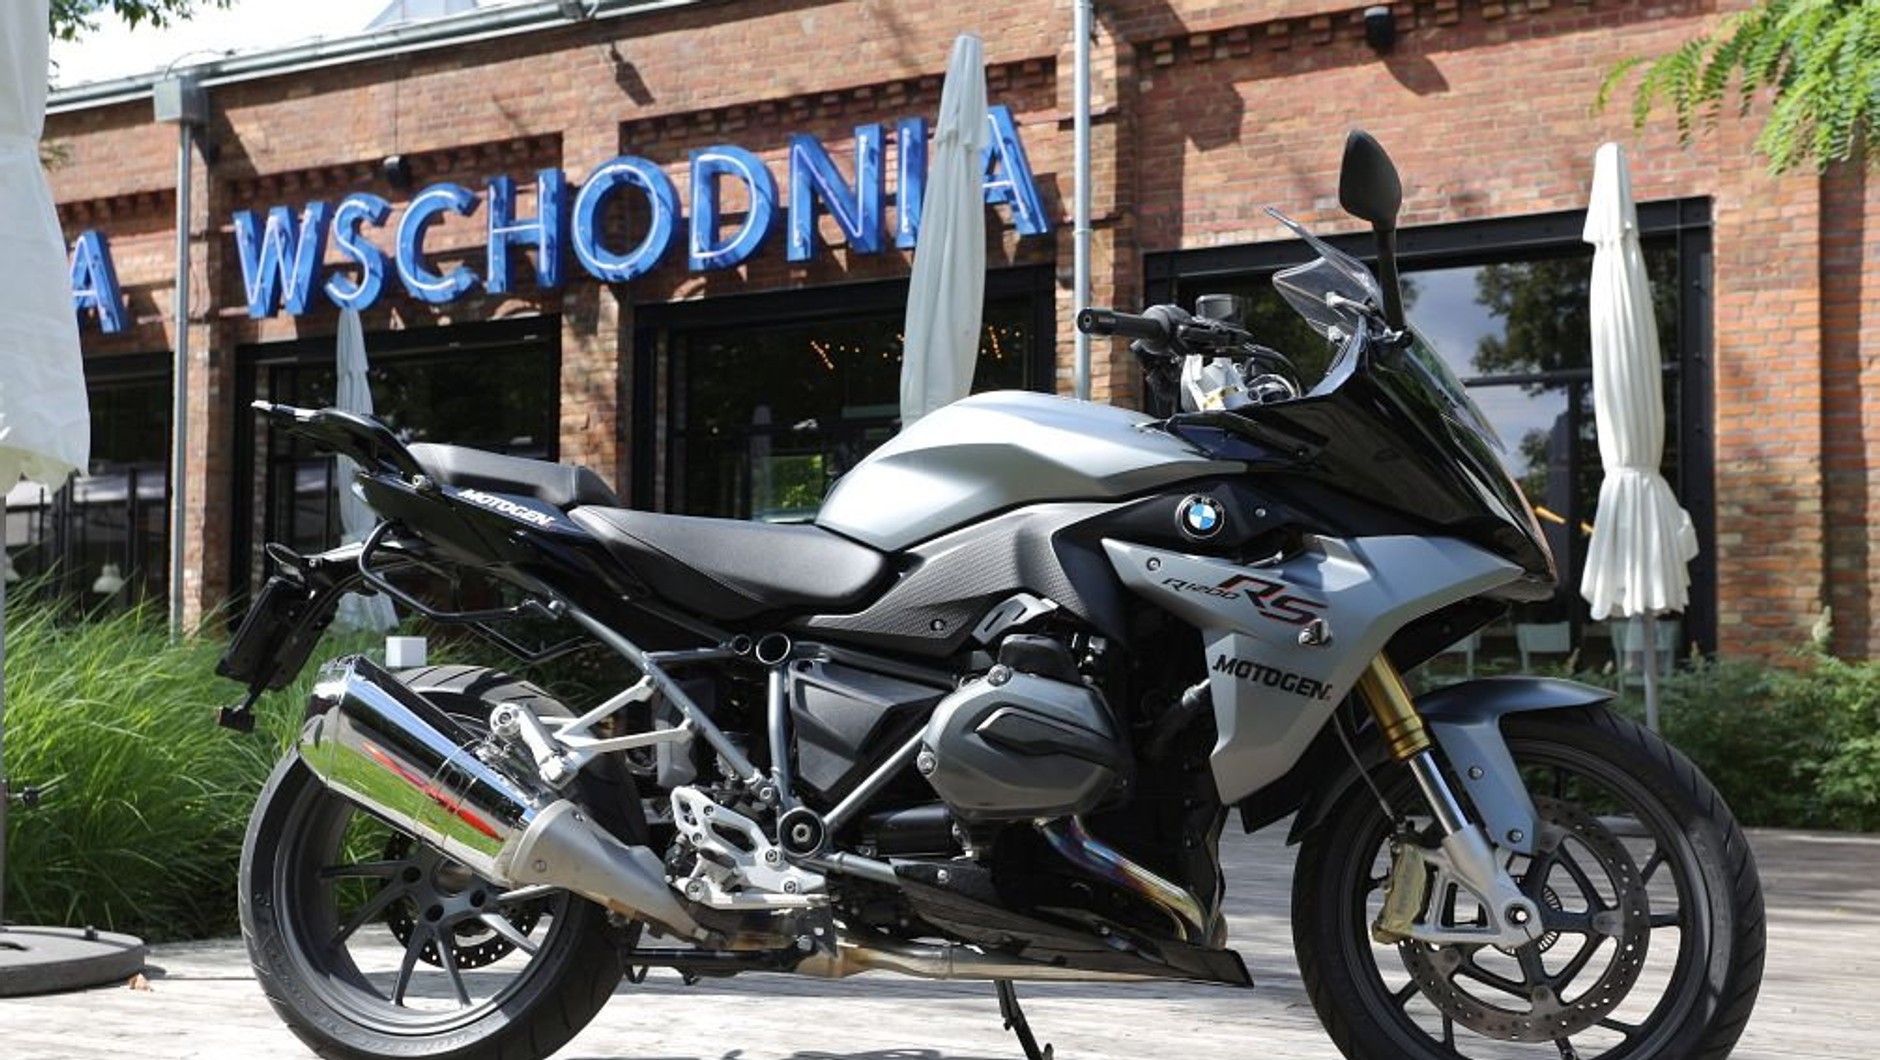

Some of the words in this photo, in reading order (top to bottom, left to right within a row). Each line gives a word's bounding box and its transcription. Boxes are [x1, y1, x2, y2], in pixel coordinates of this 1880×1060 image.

[232, 104, 1052, 319] WSCHODNIA
[1161, 577, 1240, 601] R1200
[1218, 573, 1329, 626] RS
